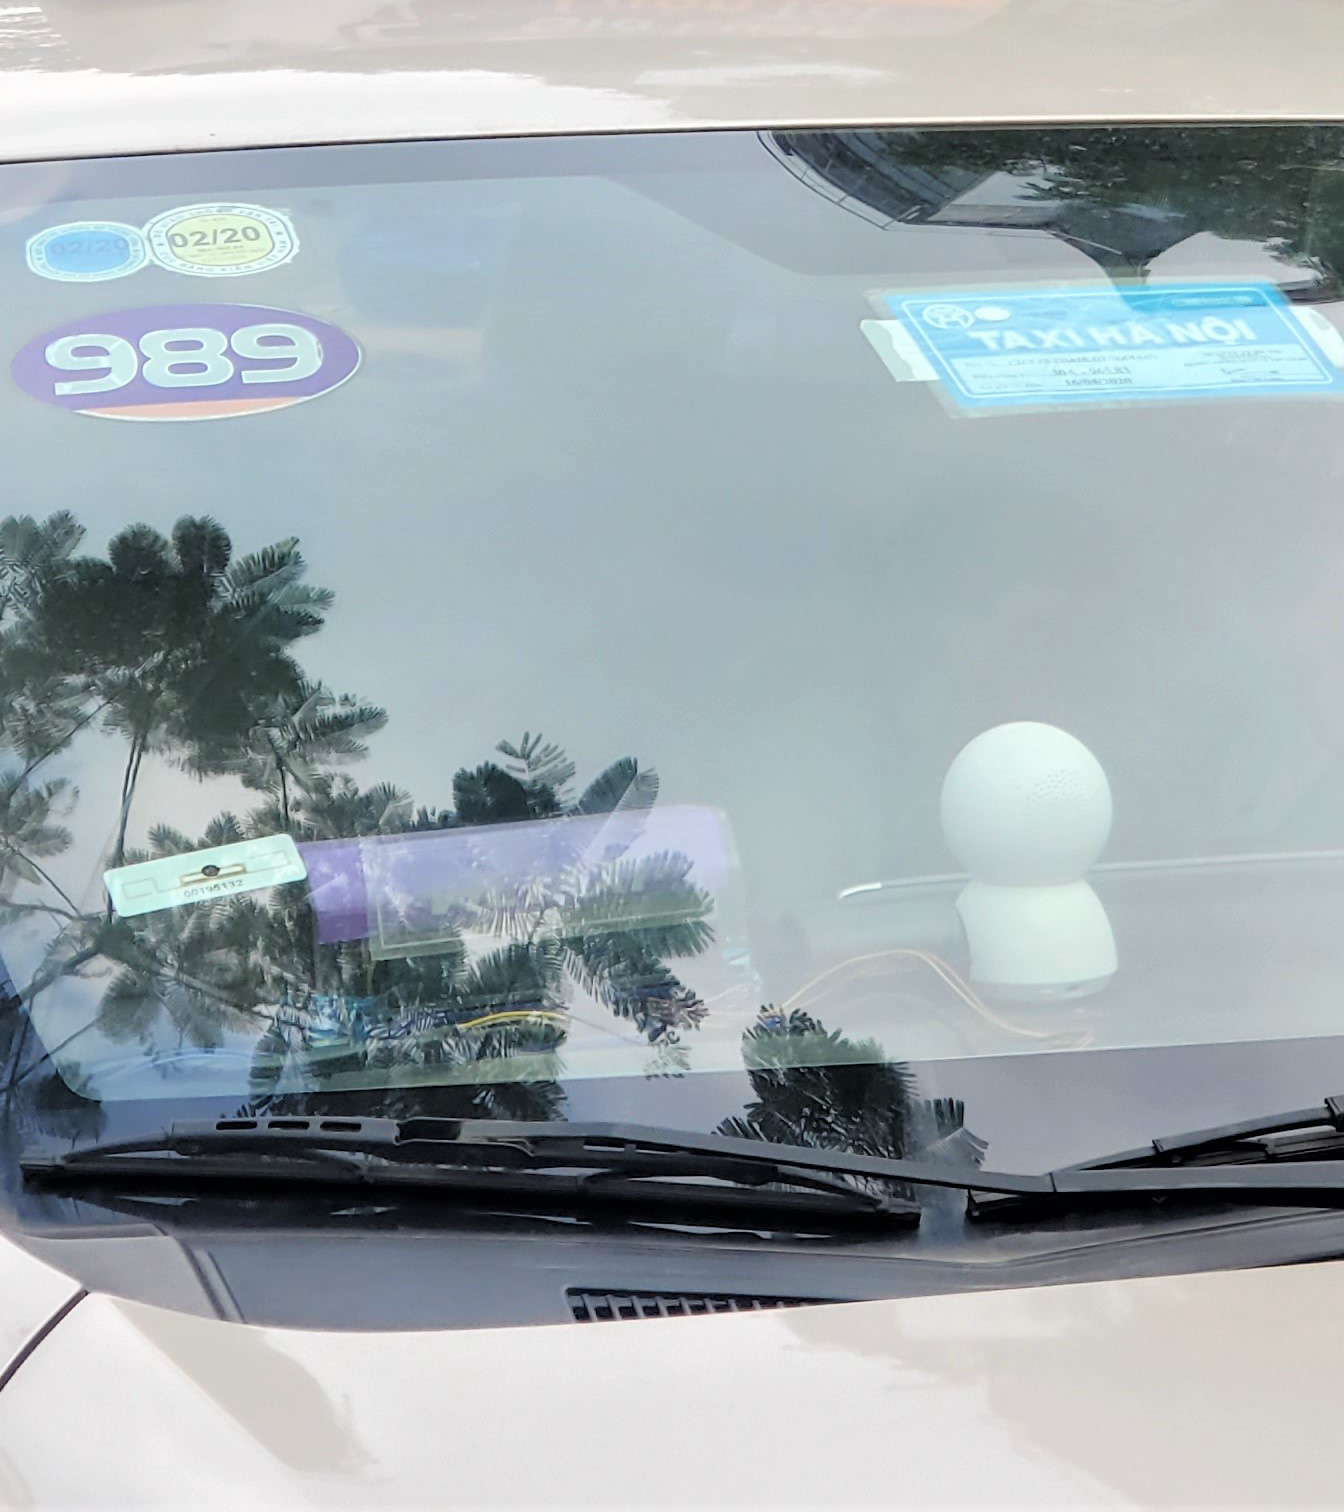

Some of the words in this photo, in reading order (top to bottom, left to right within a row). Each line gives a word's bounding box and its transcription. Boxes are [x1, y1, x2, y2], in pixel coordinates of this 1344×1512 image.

[167, 225, 261, 249] 02/20
[967, 328, 1086, 352] TAXI
[1166, 314, 1258, 346] NỘI
[45, 323, 324, 395] 989
